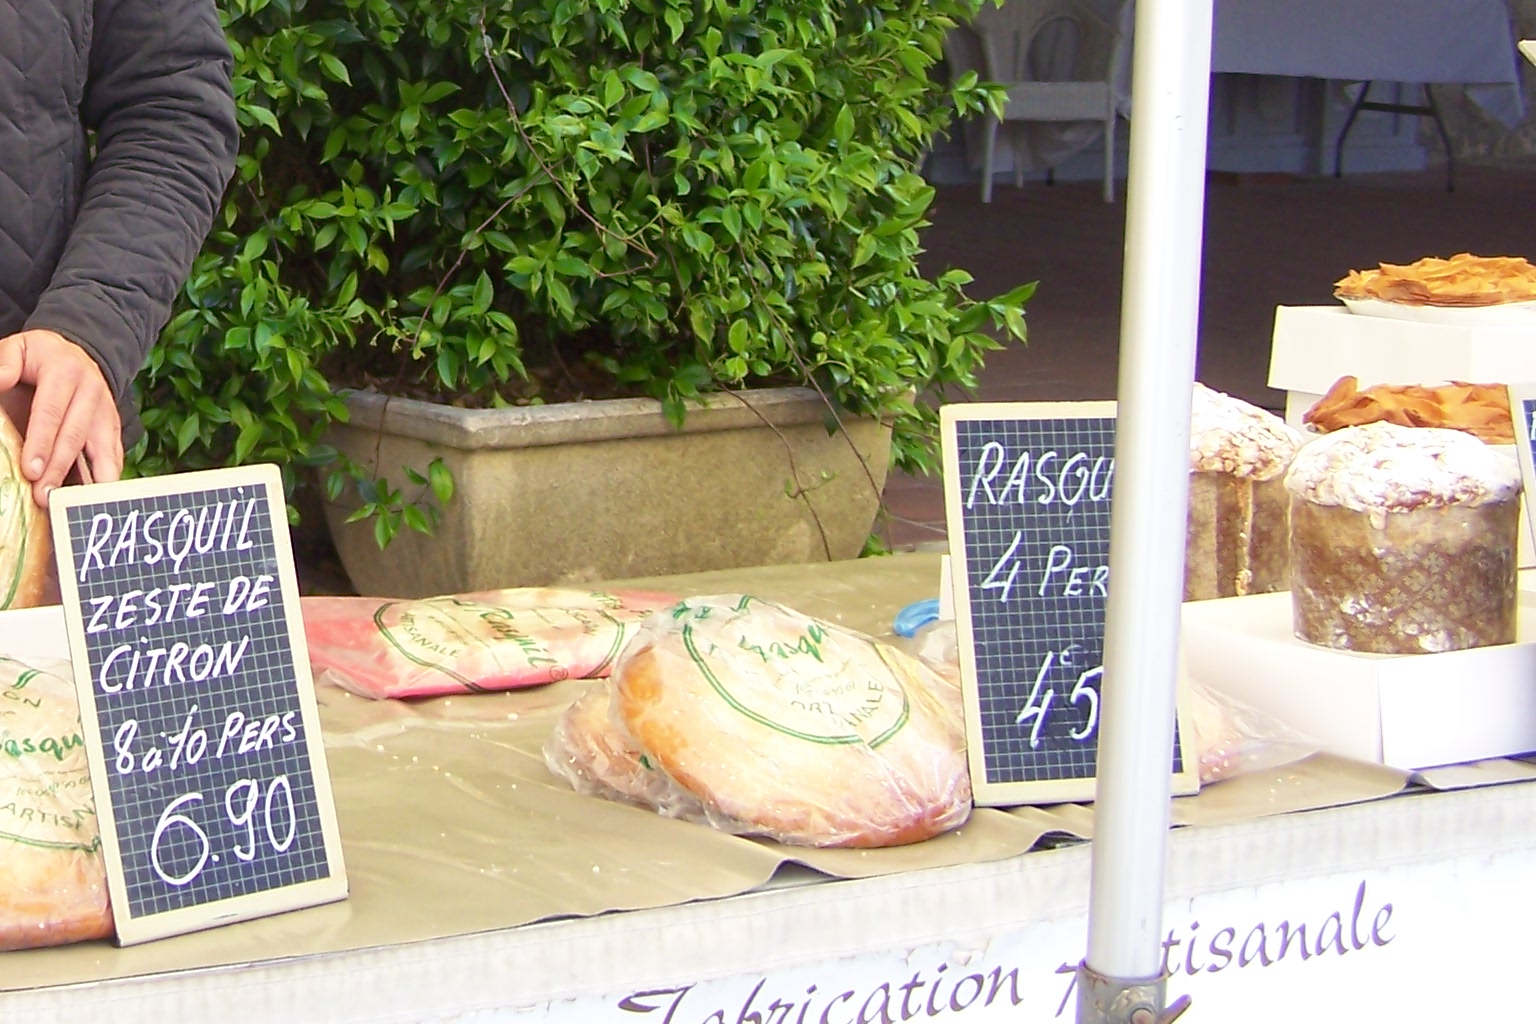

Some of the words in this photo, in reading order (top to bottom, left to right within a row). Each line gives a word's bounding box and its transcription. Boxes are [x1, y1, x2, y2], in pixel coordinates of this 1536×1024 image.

[966, 441, 1115, 524] RASQU
[80, 486, 256, 583] RASQUIL
[980, 530, 1022, 603] 4
[1038, 545, 1109, 597] PER
[87, 582, 215, 634] ZESTE
[222, 575, 274, 615] DE
[113, 719, 138, 774] 8
[167, 704, 208, 770] 10
[215, 711, 297, 759] PERS
[150, 774, 297, 886] 6.90
[1055, 879, 1396, 1017] tisanale
